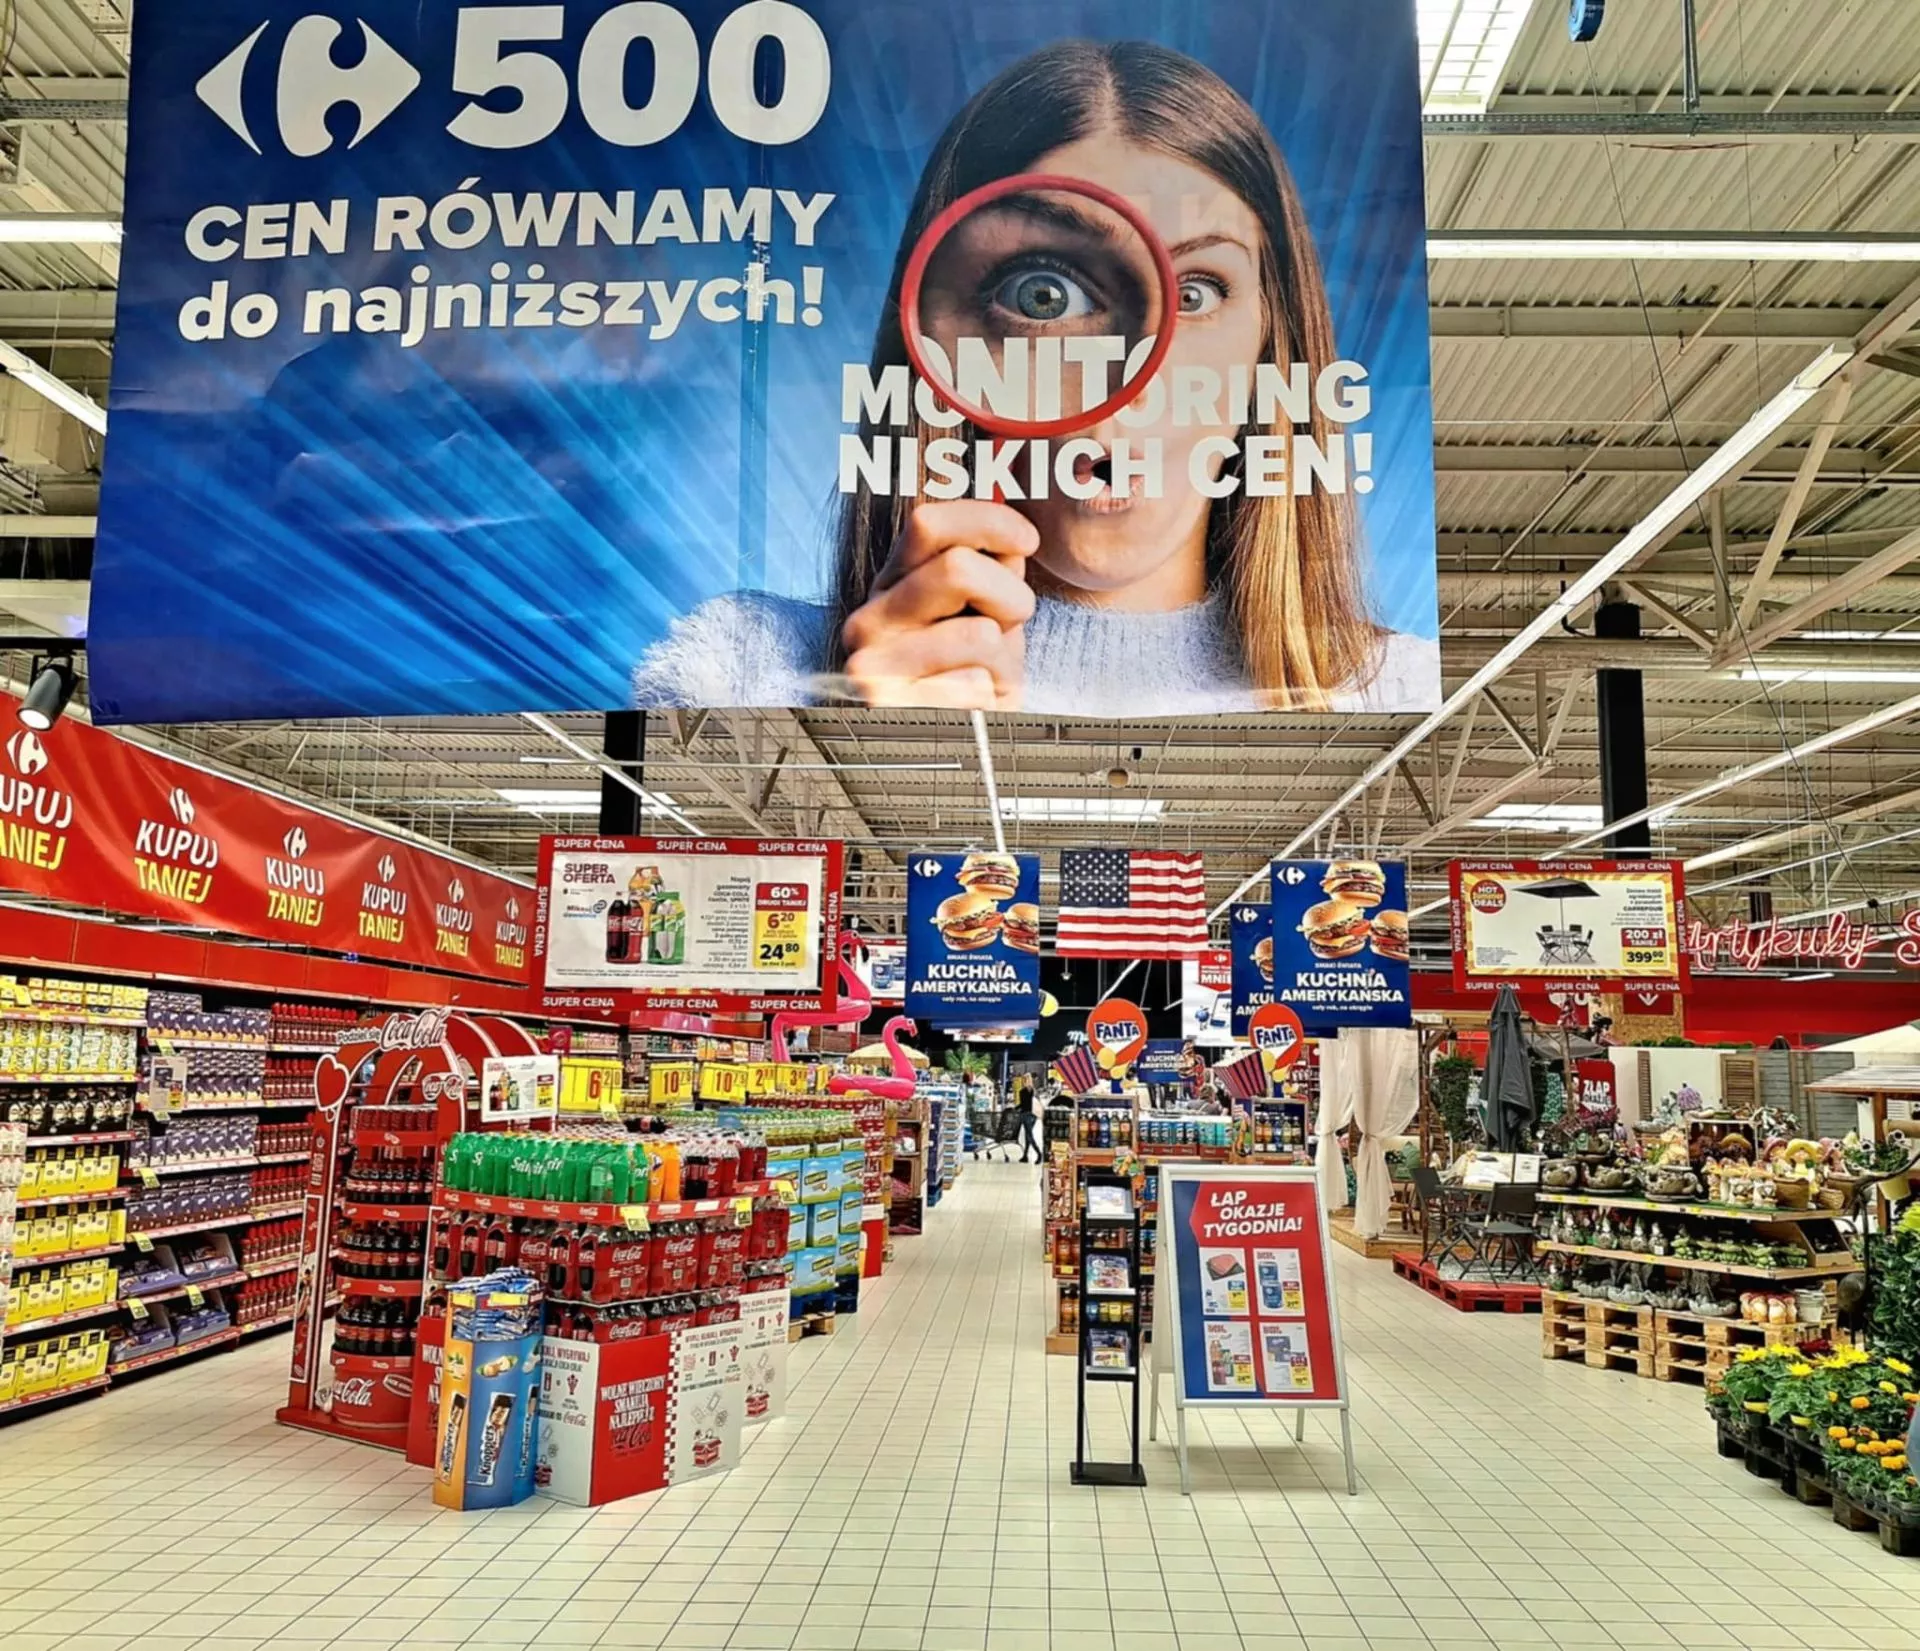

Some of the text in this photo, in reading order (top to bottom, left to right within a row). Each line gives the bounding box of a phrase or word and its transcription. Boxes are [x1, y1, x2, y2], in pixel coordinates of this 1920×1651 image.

[446, 0, 832, 150] 500
[185, 177, 836, 262] CEN RÓWNAMY
[179, 263, 826, 348] do najniższych!
[839, 432, 1374, 500] NISKICH CEN!
[135, 819, 218, 869] KUPUJ
[554, 838, 625, 850] SUPER CENA
[656, 840, 727, 851] SUPER CENA
[758, 842, 828, 852] SUPER CENA
[564, 863, 608, 874] SUPER
[1461, 862, 1514, 870] SUPER CENA
[1538, 862, 1593, 871] SUPER CENA
[1617, 862, 1645, 870] SUPER
[134, 856, 213, 904] TANIEJ
[265, 856, 325, 896] KUPUJ
[563, 873, 615, 884] OFERTA
[362, 881, 407, 915] KUPUJ
[770, 886, 800, 899] 60%
[267, 889, 325, 927] TANIEJ
[436, 903, 473, 932] KUPUJ
[533, 886, 548, 957] SUPER CENA
[827, 891, 839, 961] SUPER CENA
[358, 911, 404, 943] TANIEJ
[496, 920, 527, 946] KUPUJ
[1625, 929, 1650, 939] 200
[436, 928, 469, 957] TANIEJ
[495, 942, 524, 968] TANIEJ
[928, 965, 1017, 979] KUCHNIA
[1296, 973, 1387, 988] KUCHNIA
[1466, 982, 1494, 990] SUPER
[1544, 982, 1600, 991] SUPER CENA
[1624, 983, 1680, 991] SUPER CENA
[543, 997, 615, 1008] SUPER CENA
[647, 998, 719, 1009] SUPER CENA
[750, 999, 821, 1010] SUPER CENA
[1095, 1022, 1141, 1040] FANTA
[1254, 1026, 1297, 1045] FANTA
[1210, 1190, 1247, 1208] ŁAP
[1219, 1203, 1285, 1221] OKAZJE
[1203, 1217, 1303, 1238] TYGODNIA!
[480, 1424, 496, 1477] Knoppers
